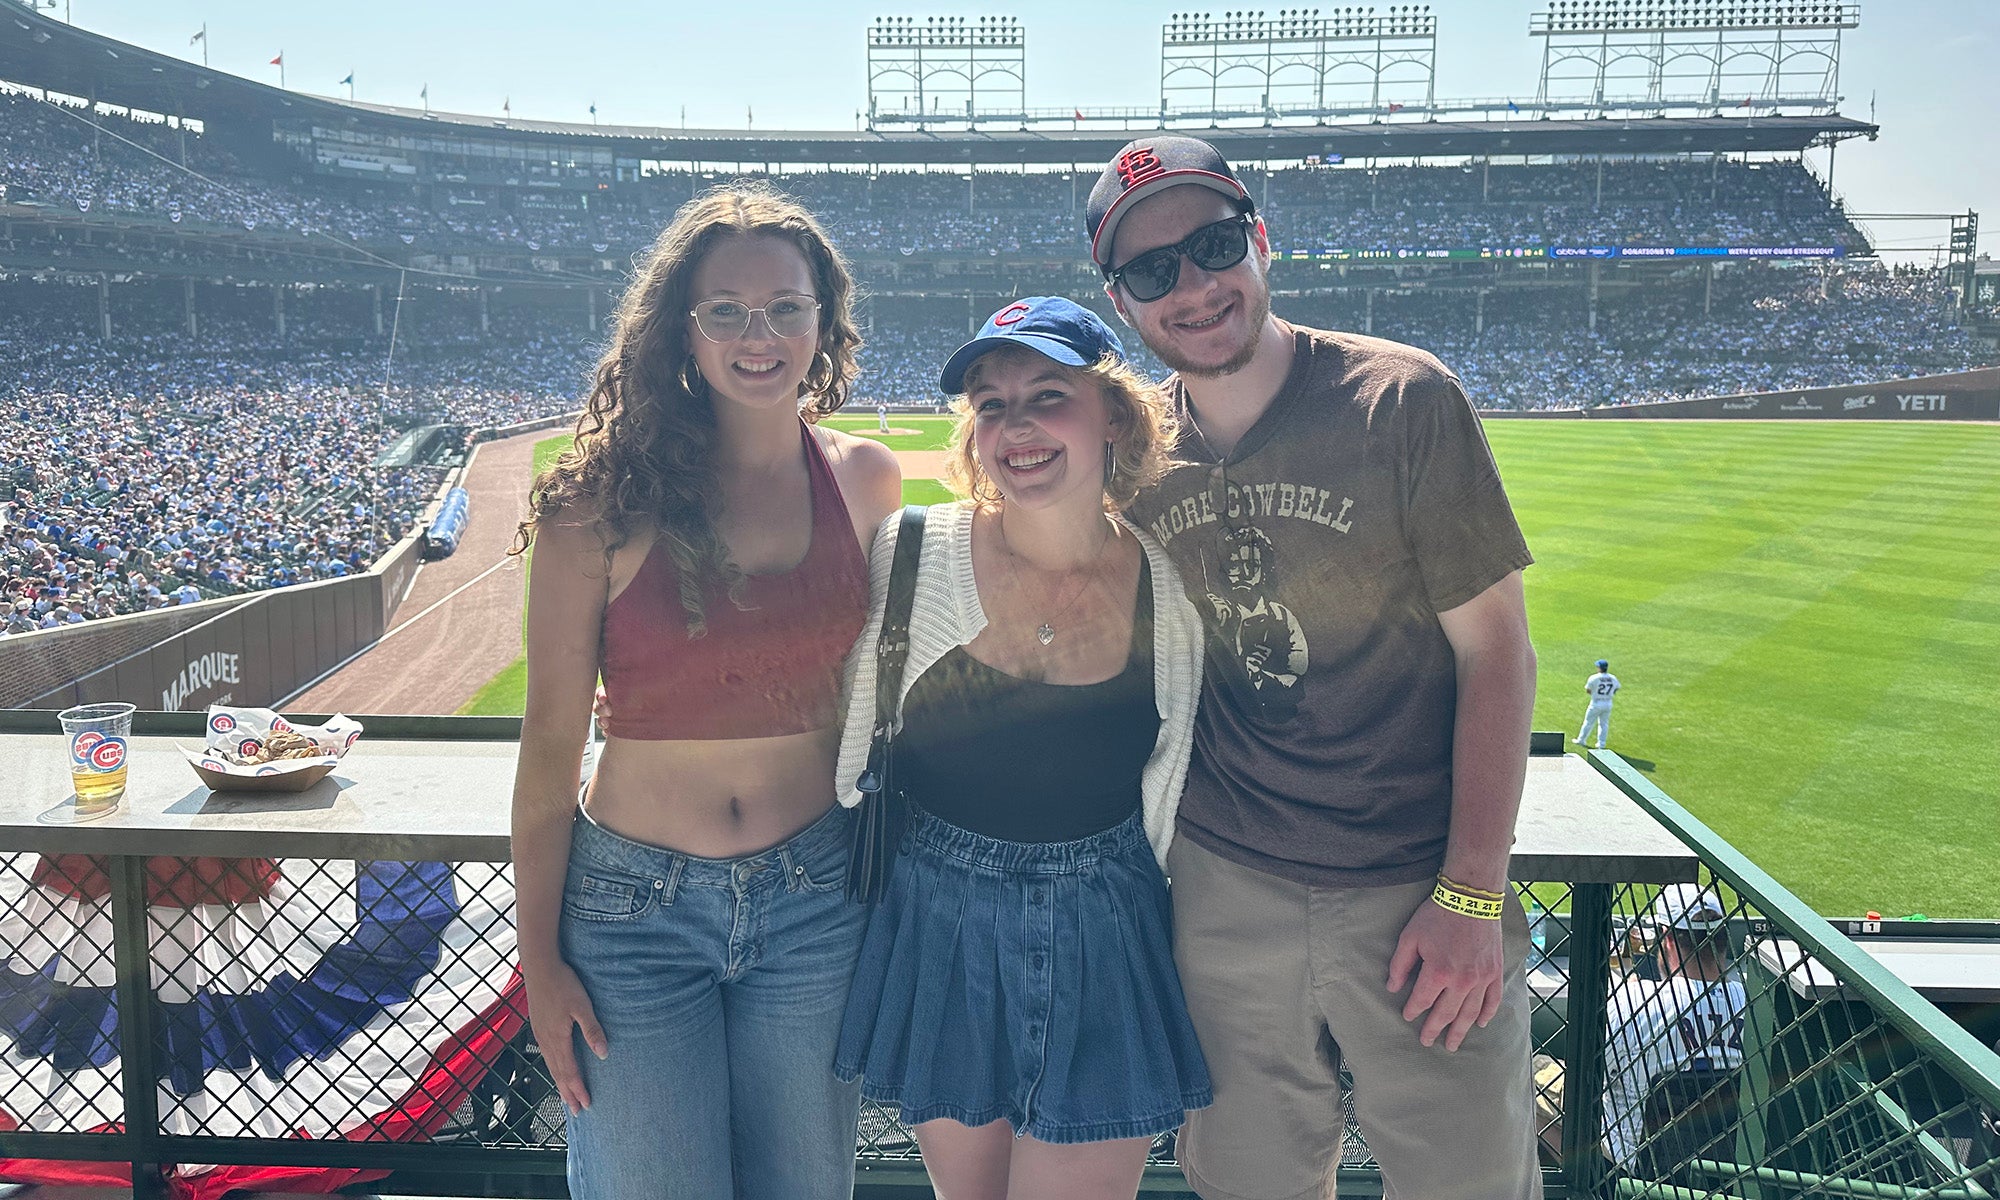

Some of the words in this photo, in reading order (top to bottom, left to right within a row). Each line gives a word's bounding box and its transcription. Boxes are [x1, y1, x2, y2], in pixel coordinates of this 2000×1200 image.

[1728, 247, 1749, 255] WITH
[1773, 247, 1793, 255] CUBS
[1794, 247, 1835, 255] STRIKEOUT
[994, 303, 1030, 326] C
[1896, 395, 1947, 411] YETI
[1151, 490, 1217, 547] MORE
[1227, 482, 1354, 535] COWBELL
[162, 652, 240, 712] MARQUEE
[1597, 683, 1614, 696] 27
[94, 743, 123, 767] CUBS
[1437, 887, 1445, 898] 21
[1449, 894, 1461, 905] 21
[1466, 899, 1478, 909] 21
[1482, 902, 1492, 910] 21
[1754, 923, 1767, 932] 51
[1868, 923, 1876, 931] 1
